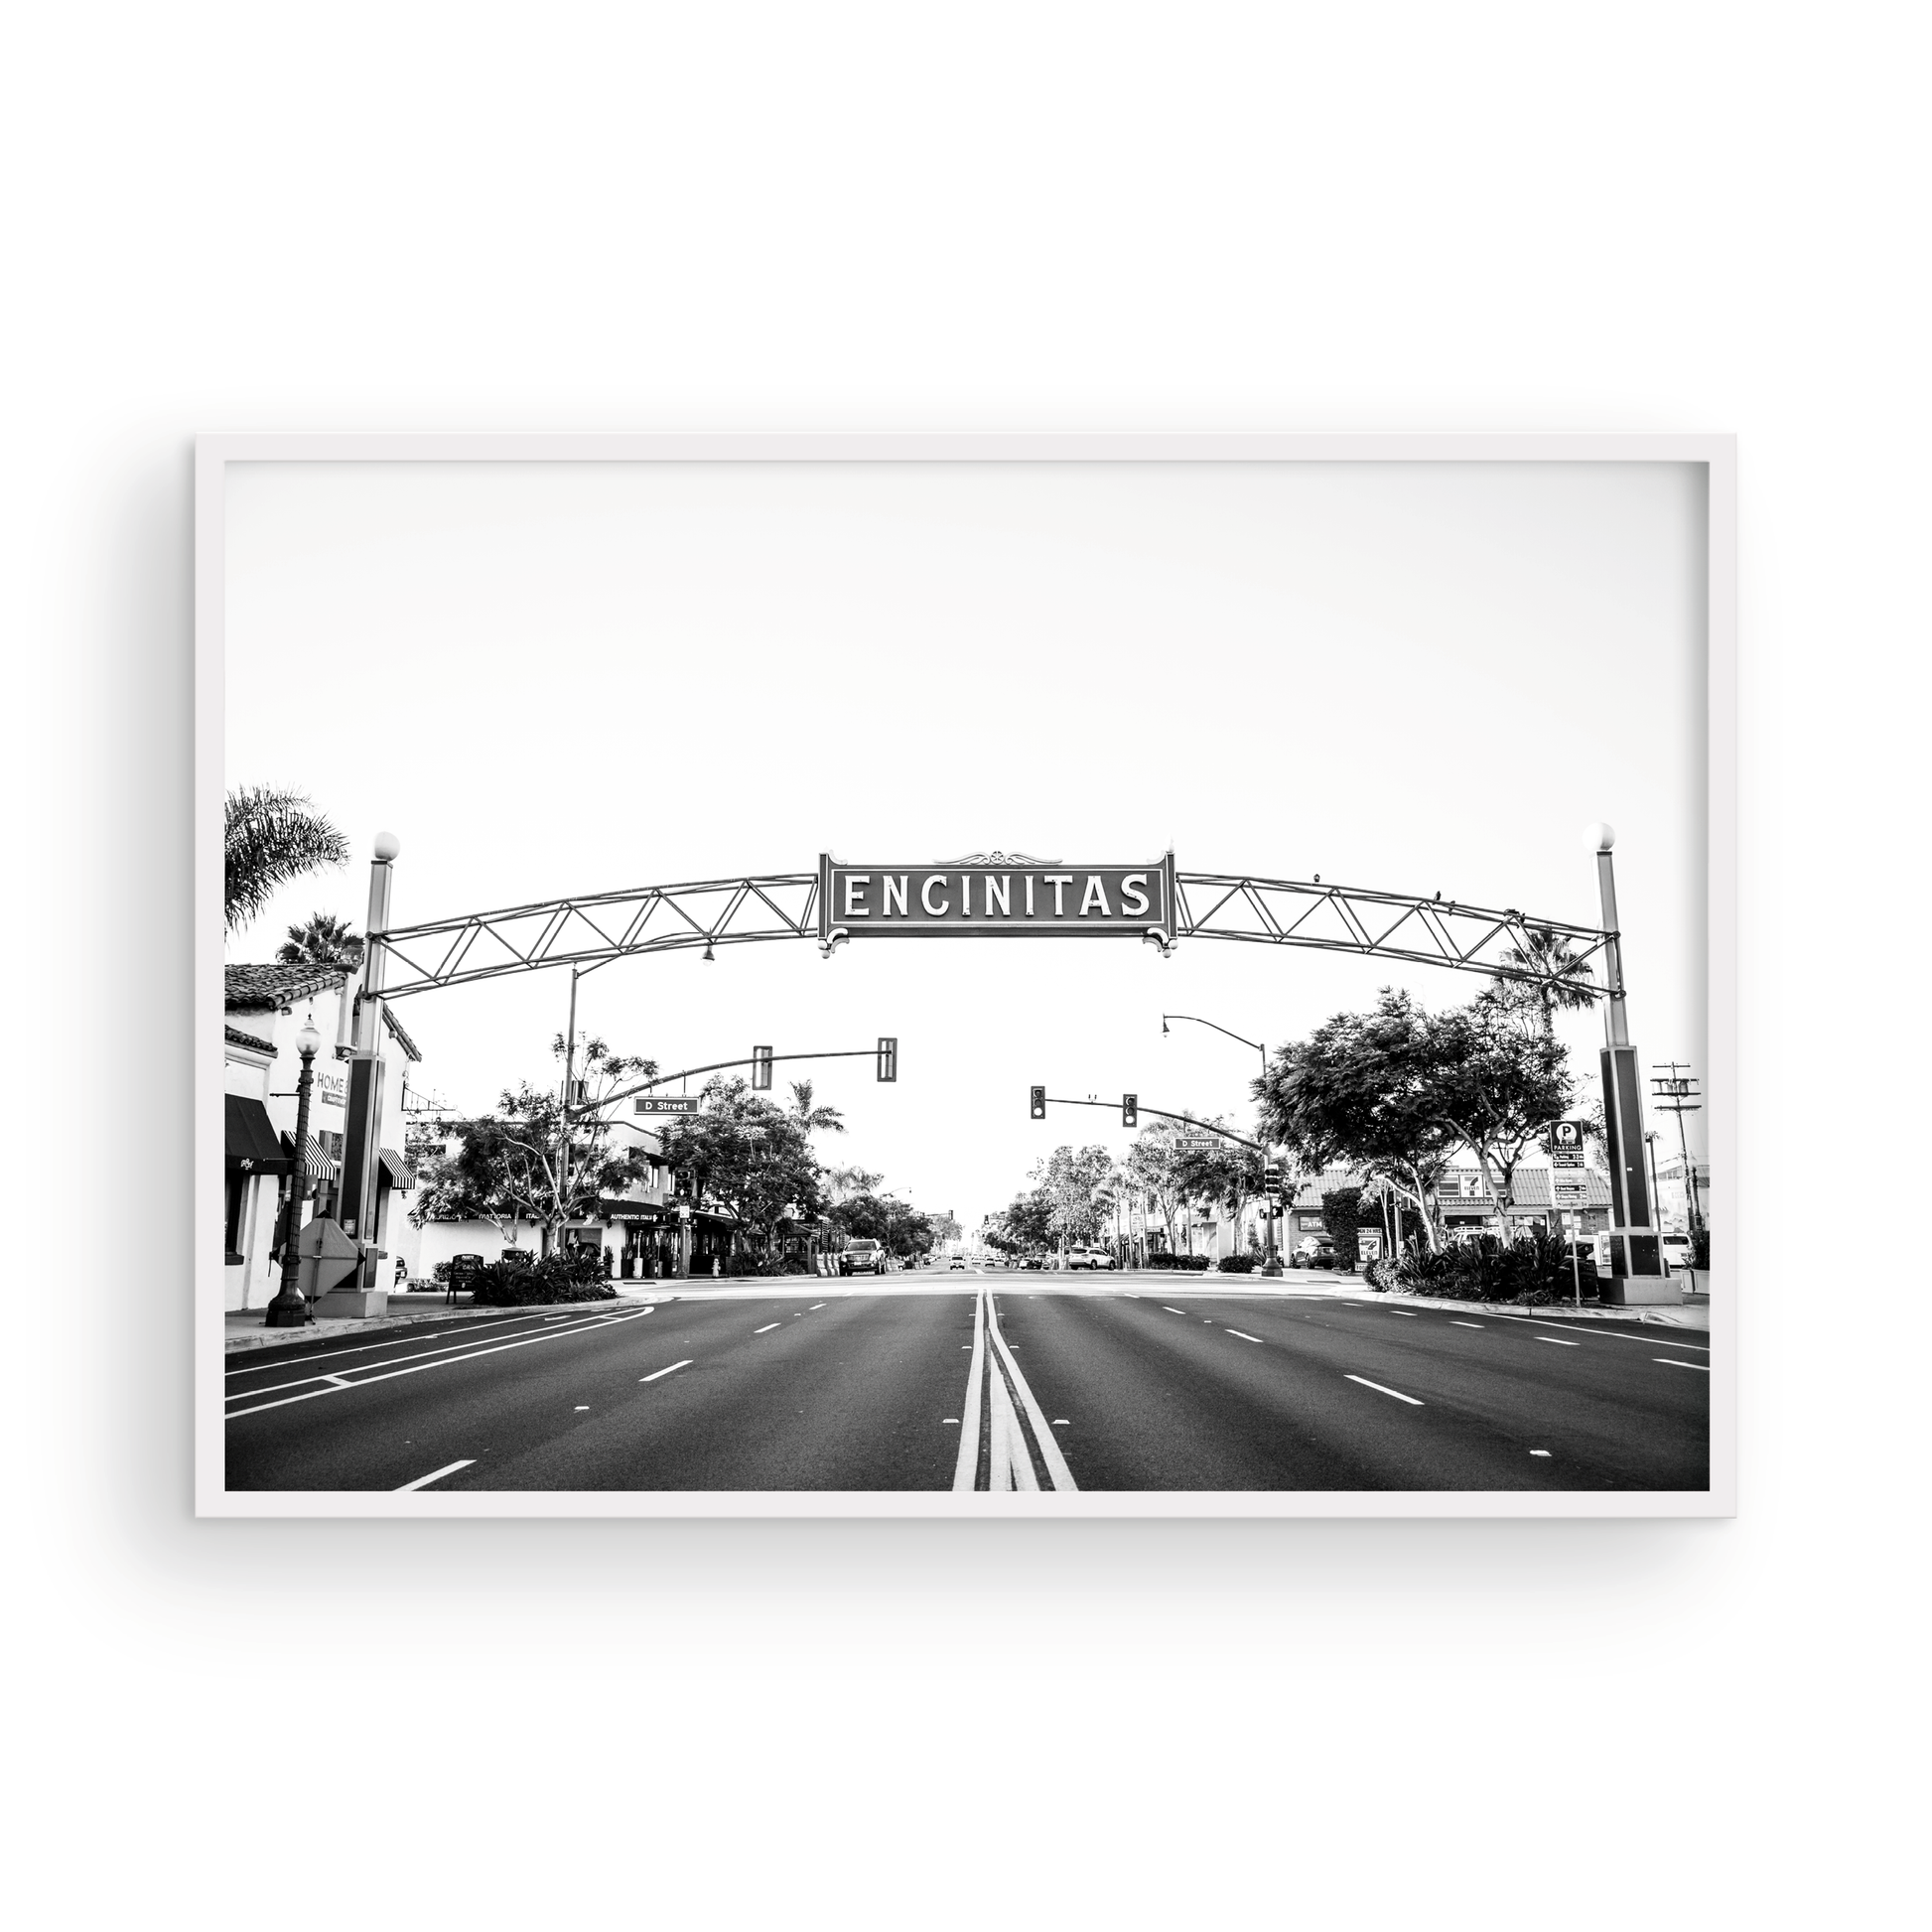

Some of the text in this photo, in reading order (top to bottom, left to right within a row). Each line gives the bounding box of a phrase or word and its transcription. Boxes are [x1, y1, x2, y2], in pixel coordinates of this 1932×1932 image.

[845, 874, 1149, 916] ENCINITAS
[317, 1071, 345, 1093] HOME
[645, 1101, 688, 1110] D Street
[1563, 1126, 1572, 1137] P
